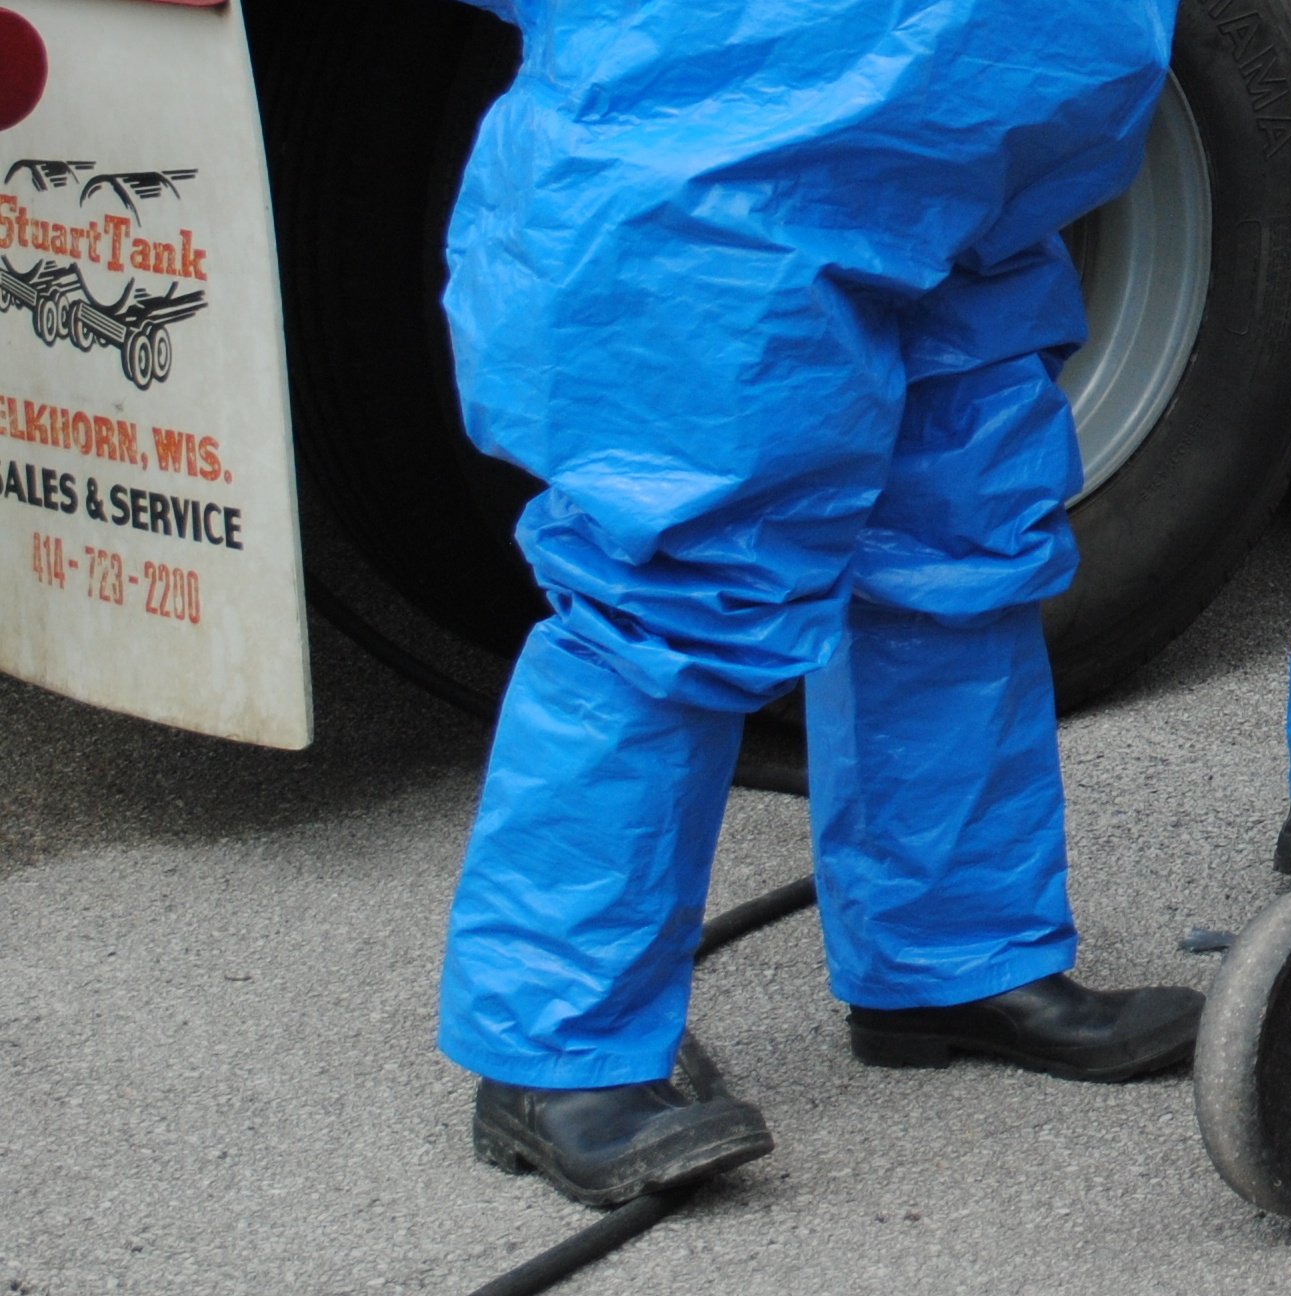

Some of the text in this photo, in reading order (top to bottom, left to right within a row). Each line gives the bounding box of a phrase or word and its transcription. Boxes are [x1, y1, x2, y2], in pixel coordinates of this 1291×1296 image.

[152, 425, 233, 485] WIS.
[0, 459, 244, 551] ALES & SERVICE
